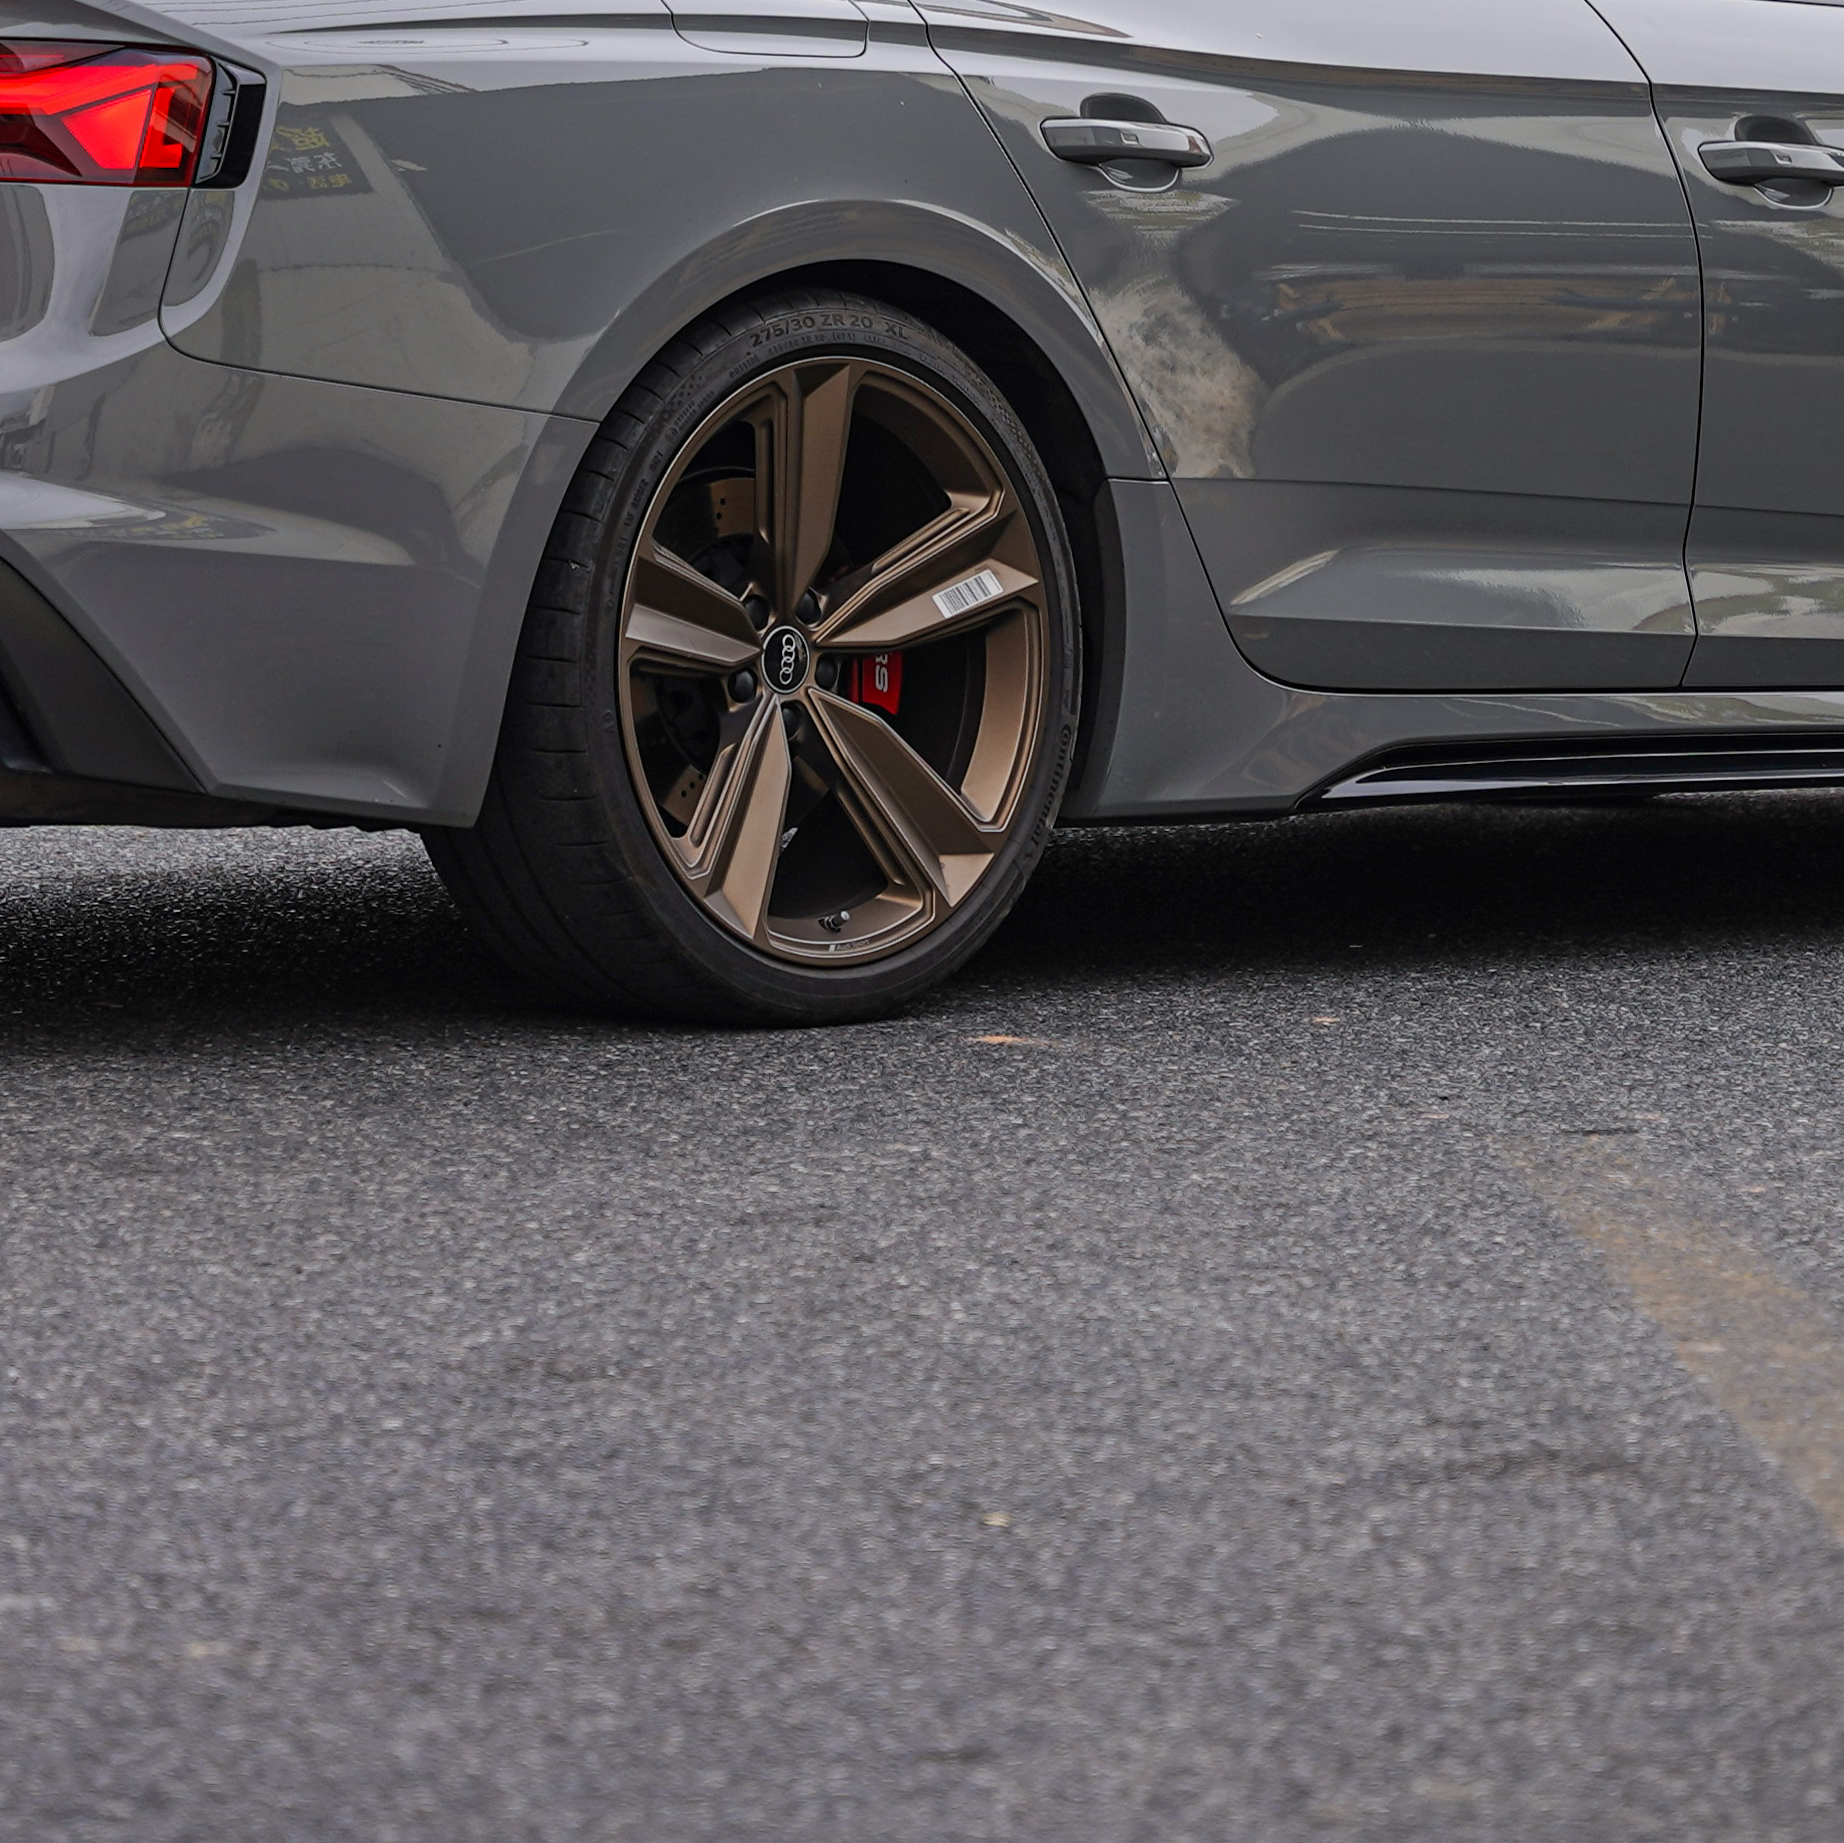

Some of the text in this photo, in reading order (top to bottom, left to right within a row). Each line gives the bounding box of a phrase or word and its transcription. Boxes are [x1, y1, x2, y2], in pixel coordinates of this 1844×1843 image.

[749, 315, 816, 347] 275/30
[820, 313, 846, 327] ZR
[849, 314, 874, 329] 20
[884, 321, 908, 340] XL
